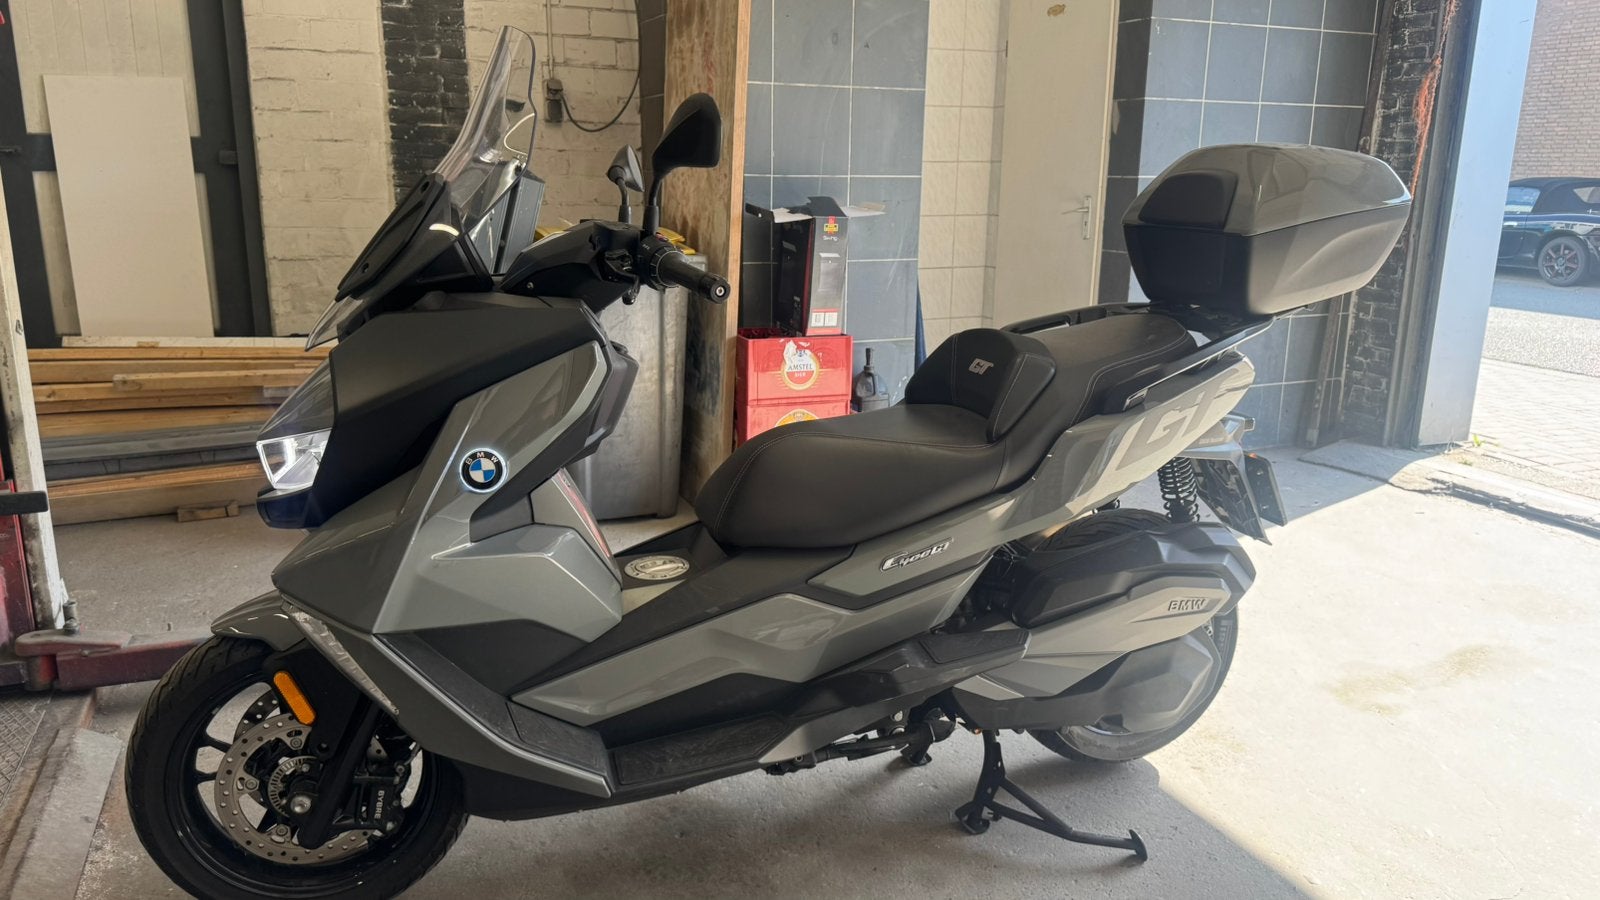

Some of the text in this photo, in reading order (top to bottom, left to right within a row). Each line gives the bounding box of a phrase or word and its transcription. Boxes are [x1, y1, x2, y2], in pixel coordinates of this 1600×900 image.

[787, 363, 813, 371] AMSTEL
[968, 357, 994, 375] GT
[1115, 367, 1239, 471] GT
[465, 451, 499, 465] BMW
[1167, 598, 1206, 612] BMW
[373, 789, 385, 819] BYBRE
